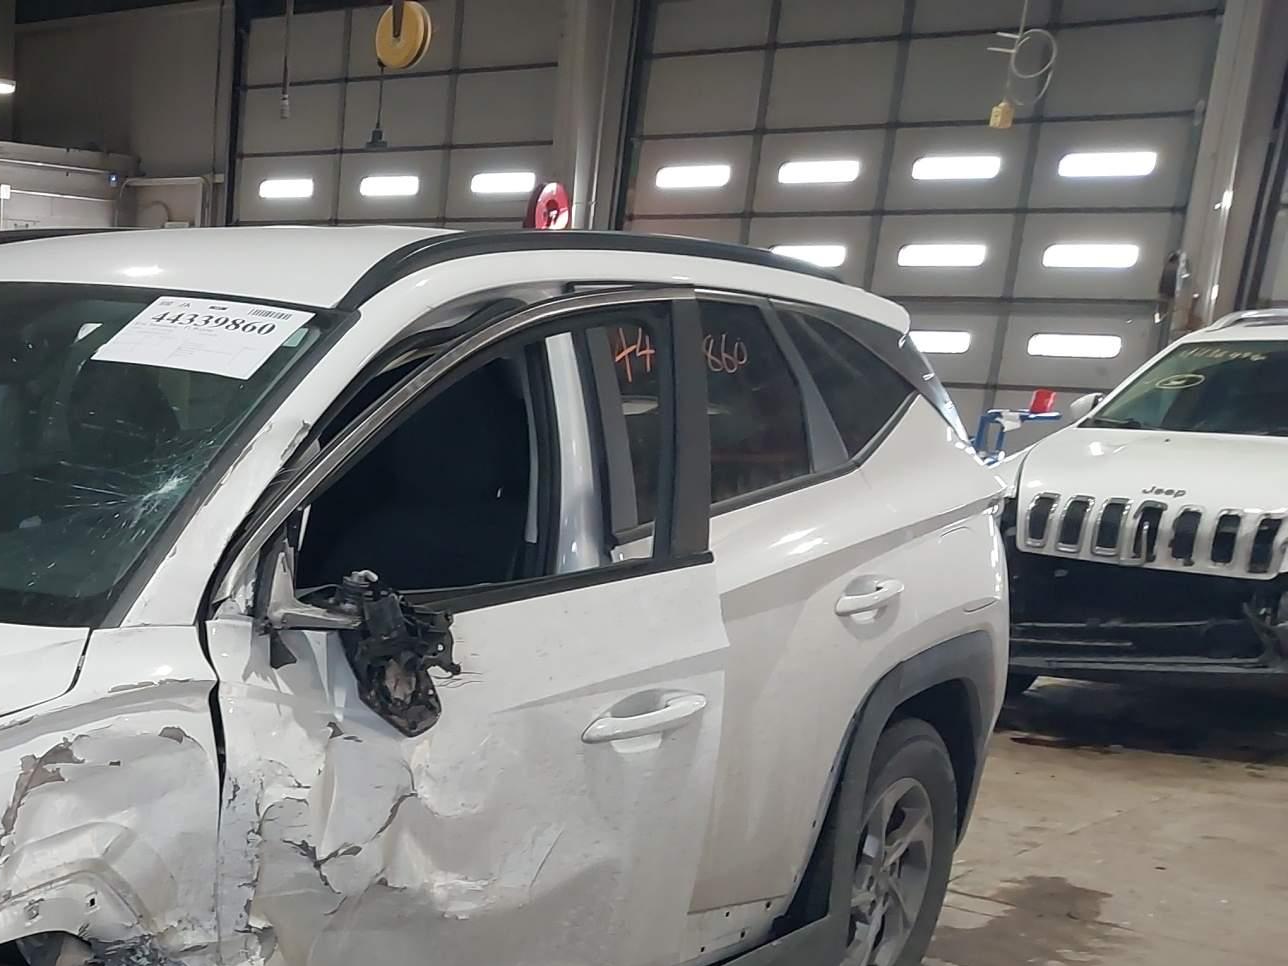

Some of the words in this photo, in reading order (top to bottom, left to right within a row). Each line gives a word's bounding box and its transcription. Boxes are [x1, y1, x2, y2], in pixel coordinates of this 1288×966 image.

[151, 311, 276, 335] 44339860
[703, 333, 748, 374] 860
[1142, 486, 1187, 498] Jeep
